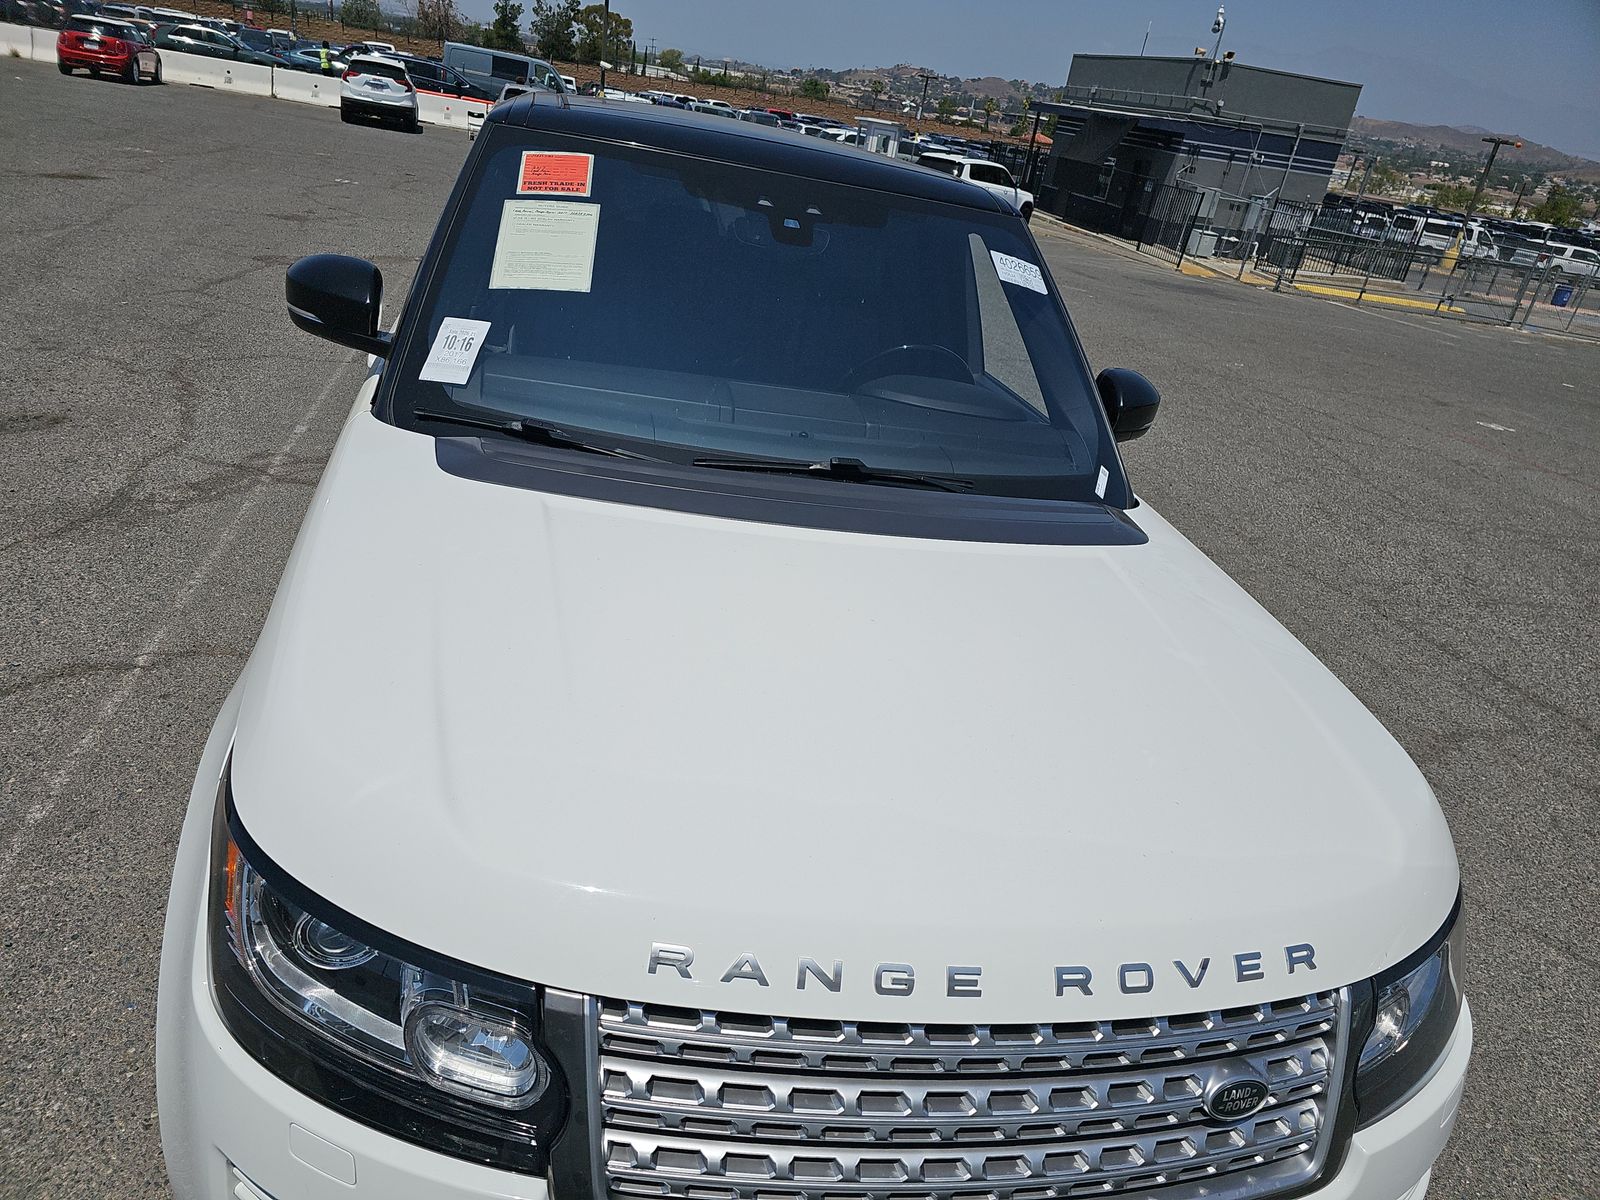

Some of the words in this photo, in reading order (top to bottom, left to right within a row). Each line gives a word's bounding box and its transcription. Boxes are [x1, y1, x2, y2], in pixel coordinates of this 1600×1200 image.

[442, 334, 475, 352] 10:16
[647, 941, 983, 998] RANGE
[1053, 942, 1318, 997] ROVER
